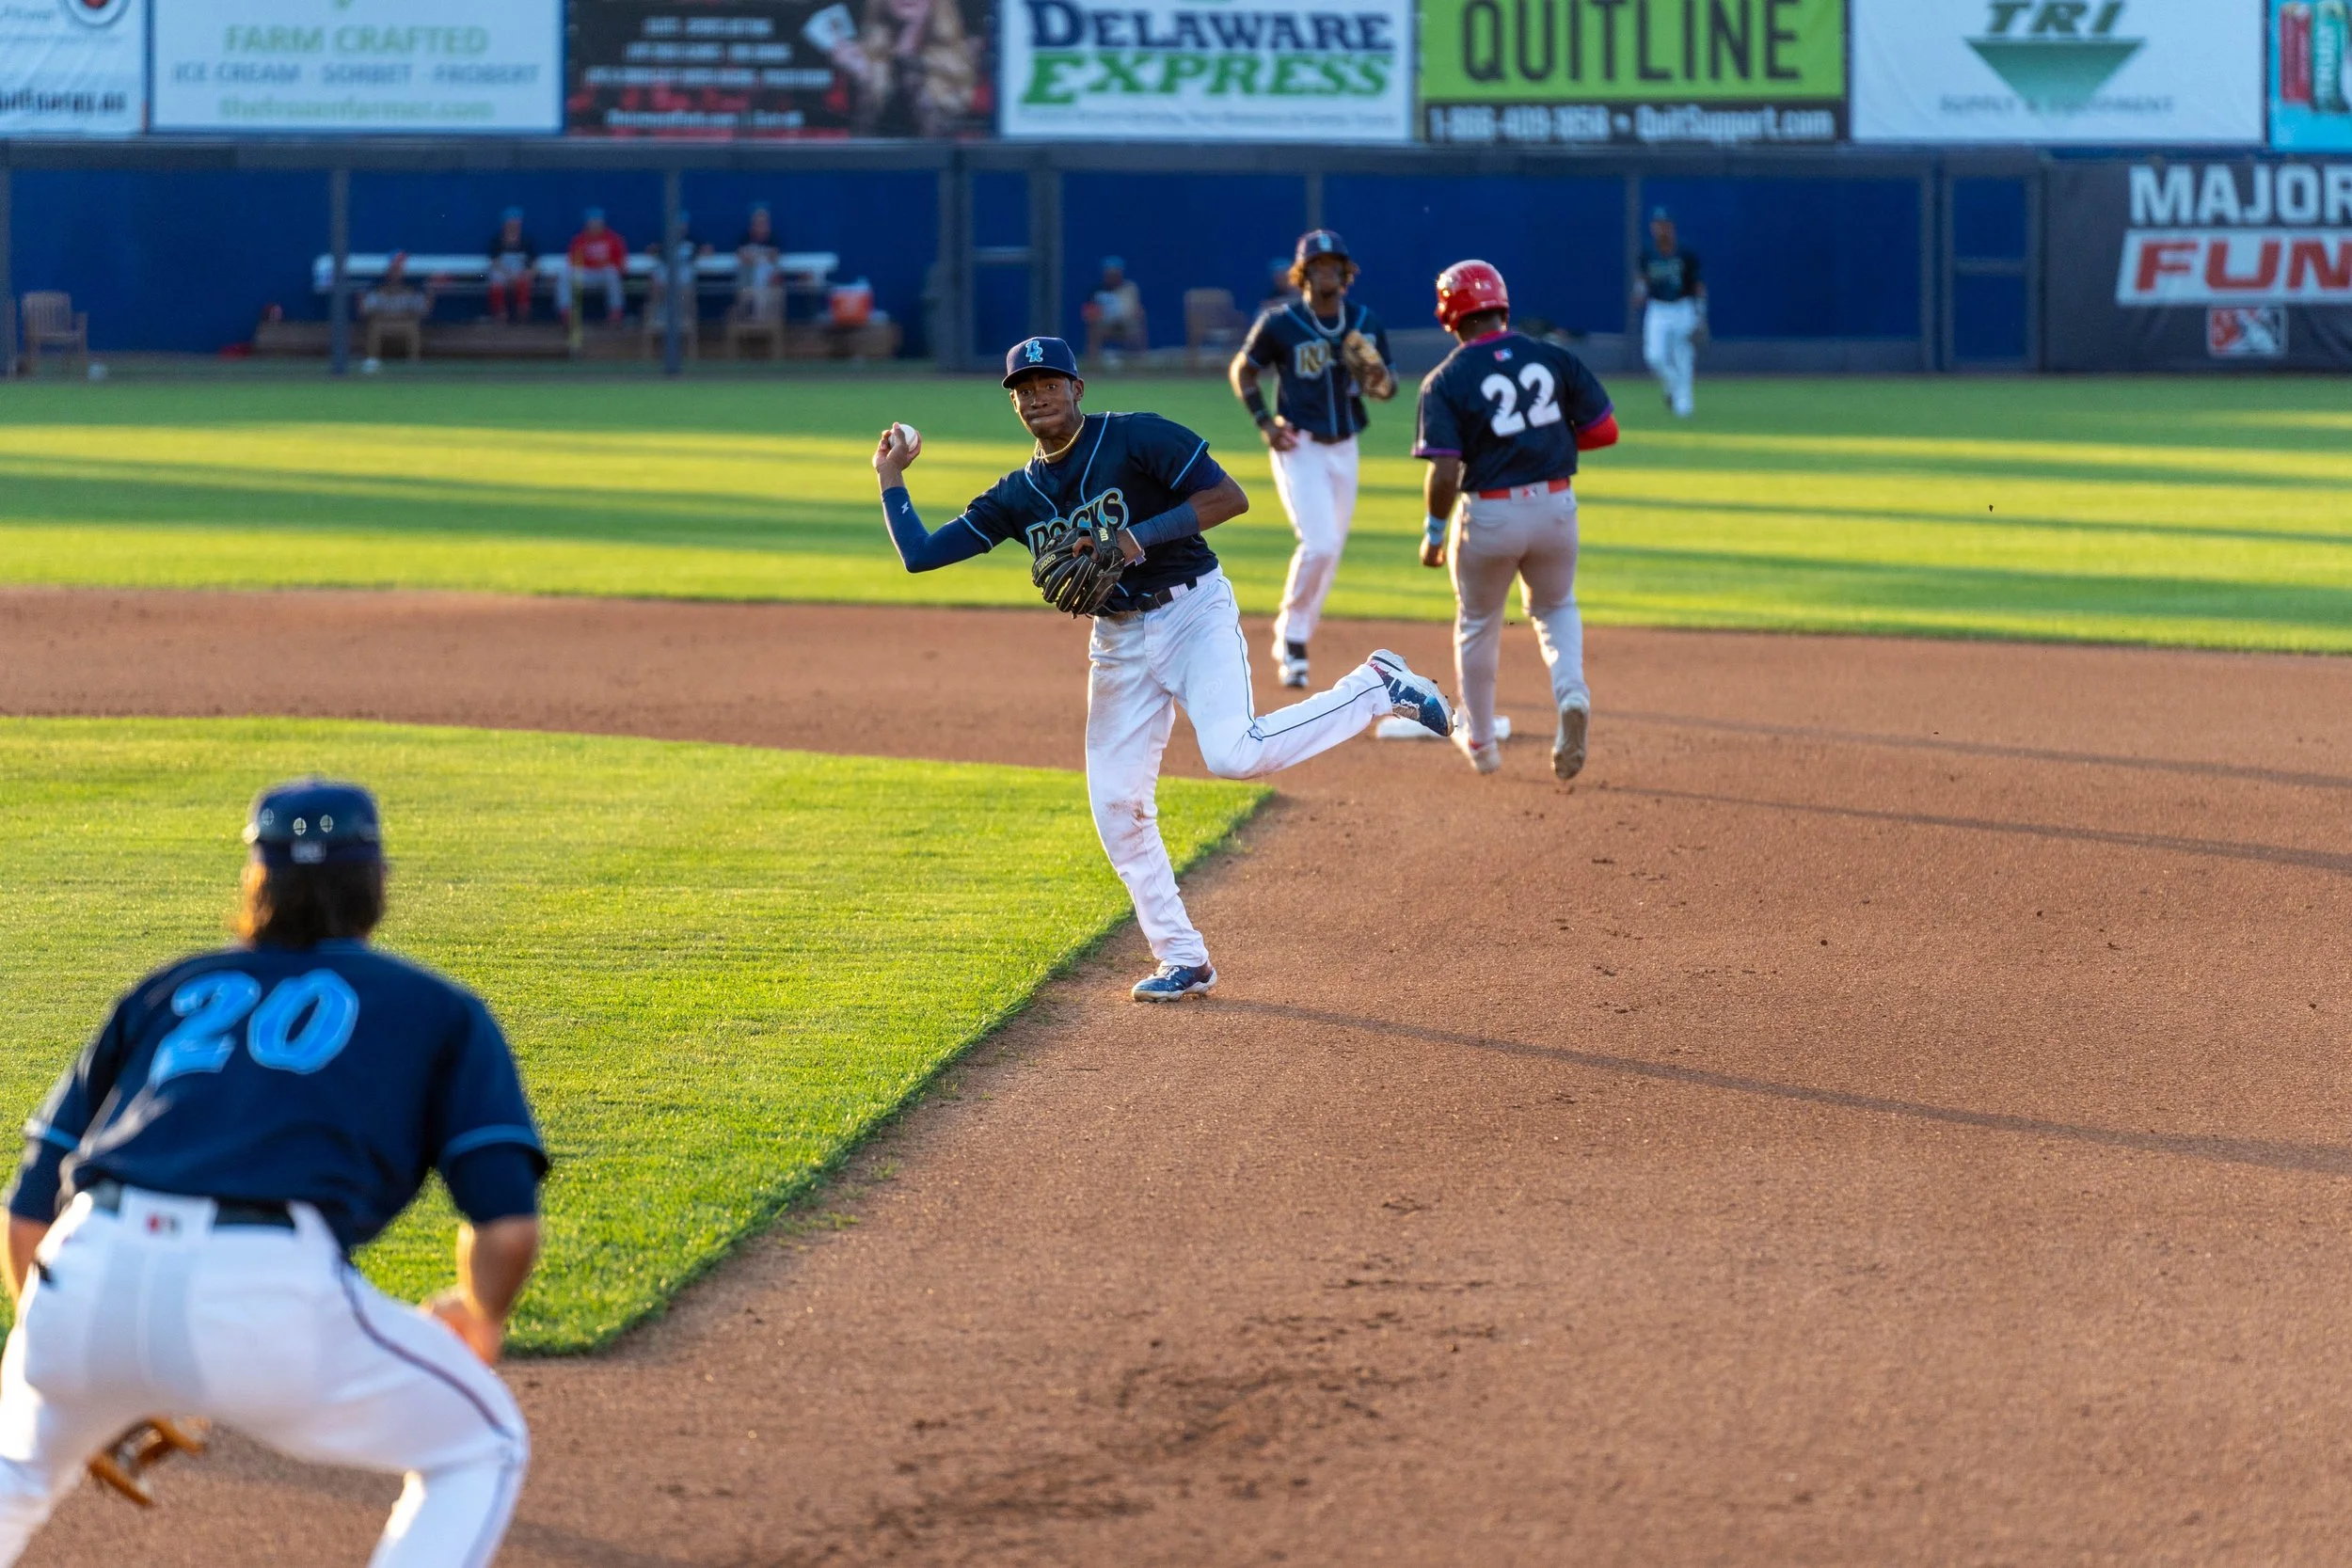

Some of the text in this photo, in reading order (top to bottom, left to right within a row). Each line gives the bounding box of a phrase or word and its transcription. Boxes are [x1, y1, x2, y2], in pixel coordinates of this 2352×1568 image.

[225, 24, 490, 55] FARM CRAFTED
[1025, 0, 1394, 51] DELAWARE
[1462, 0, 1803, 83] QUITLINE
[1986, 0, 2123, 34] TRI
[173, 62, 207, 84] ICE
[214, 62, 302, 84] CREAM
[1021, 51, 1392, 104] EXPRESS
[2128, 164, 2352, 226] MAJOR
[2133, 240, 2352, 293] FUN
[1481, 362, 1562, 438] 22
[148, 968, 360, 1082] 20
